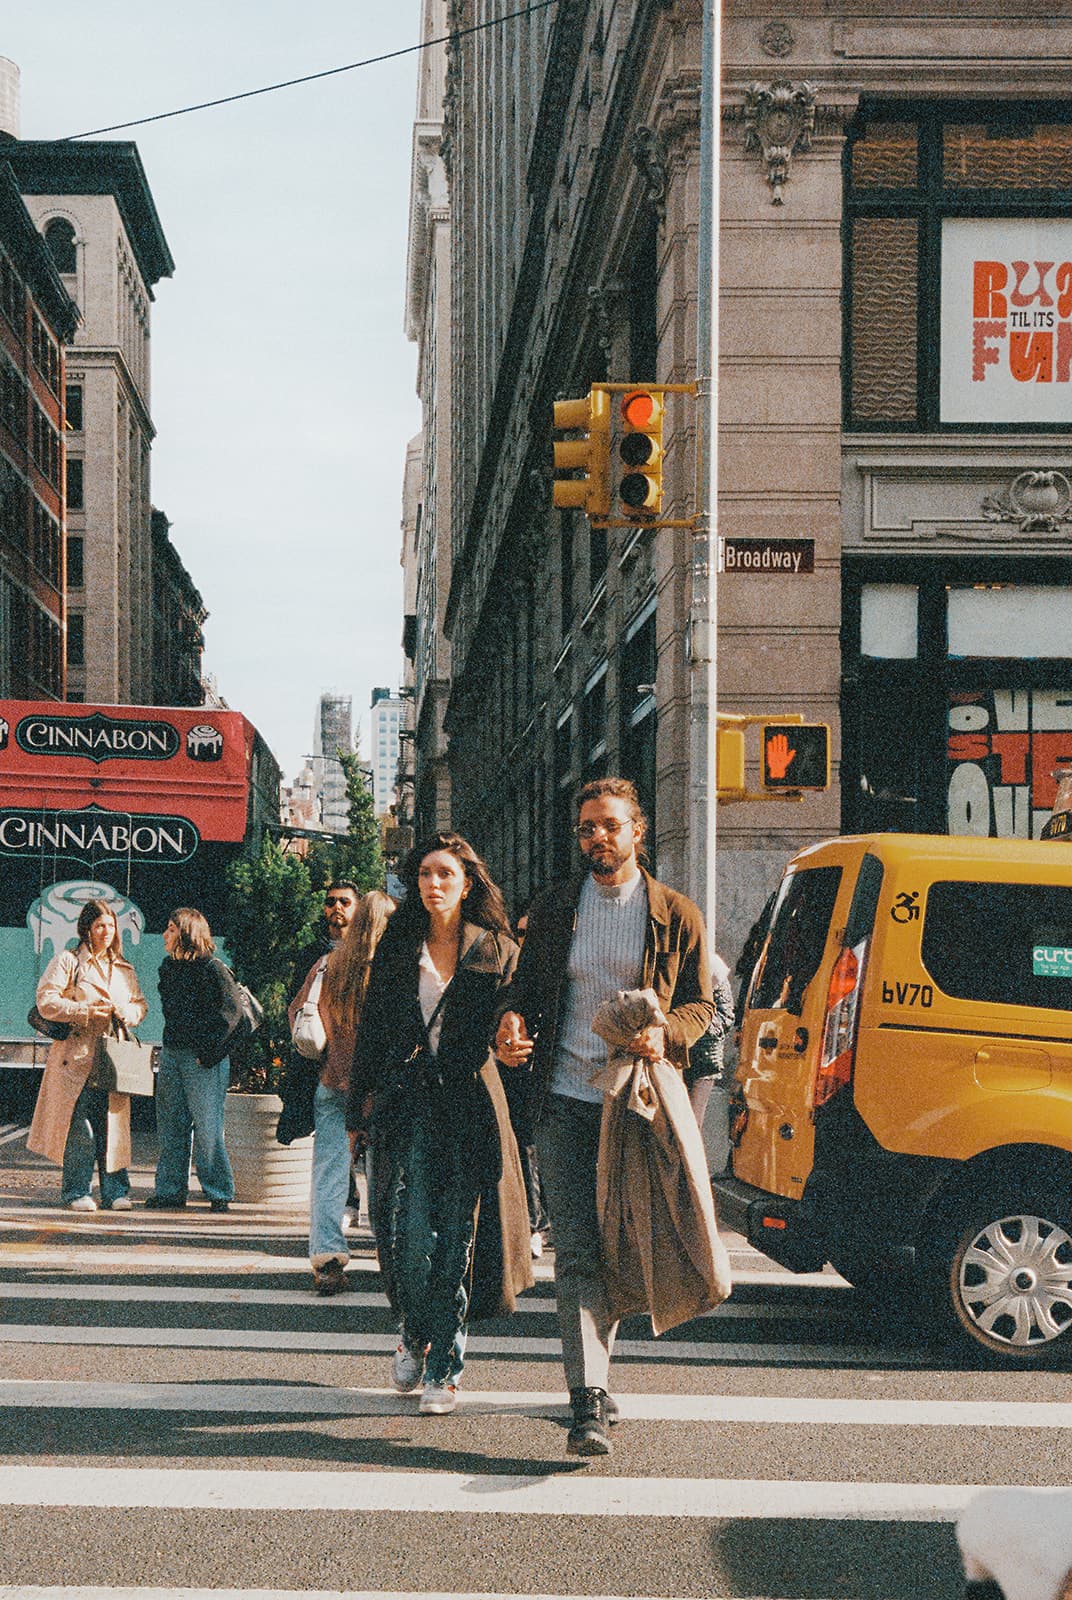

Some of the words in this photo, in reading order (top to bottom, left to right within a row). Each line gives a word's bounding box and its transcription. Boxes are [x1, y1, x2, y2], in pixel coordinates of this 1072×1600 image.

[1010, 312, 1031, 327] TIL
[1033, 312, 1054, 327] ITS
[726, 546, 801, 572] Broadway
[26, 722, 168, 750] CINNABON
[0, 817, 184, 854] CINNABON
